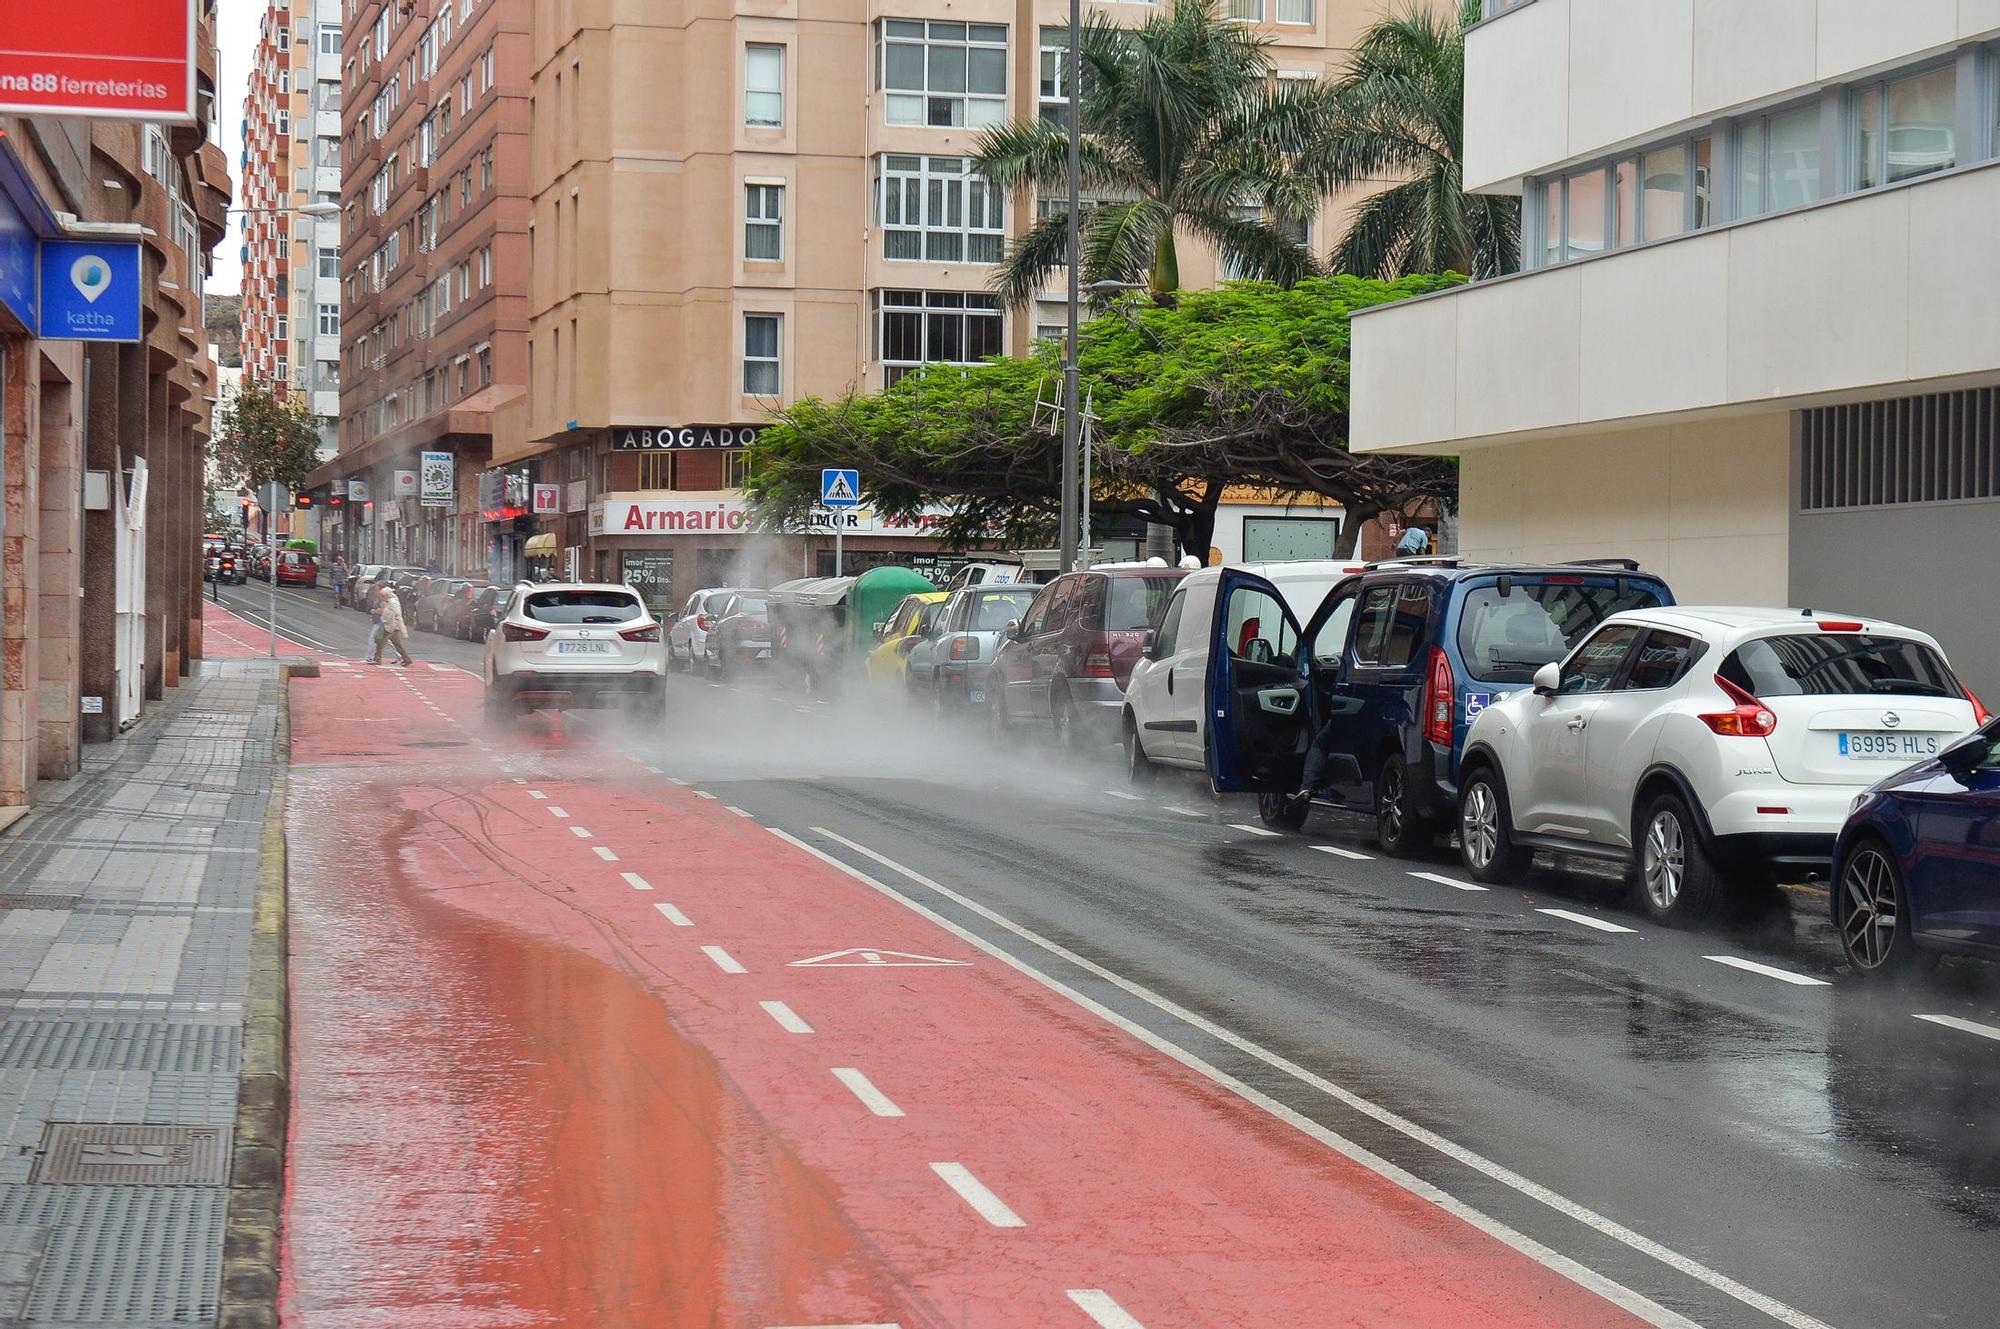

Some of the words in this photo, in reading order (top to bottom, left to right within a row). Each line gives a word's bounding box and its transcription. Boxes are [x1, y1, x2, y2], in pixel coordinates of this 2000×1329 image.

[0, 73, 58, 92] na88
[66, 310, 115, 325] katha
[625, 558, 644, 566] imor
[913, 556, 935, 565] imor
[623, 569, 656, 583] 25%
[1851, 735, 1897, 754] 6995
[1903, 736, 1938, 754] HLS
[1735, 767, 1773, 776] JUKE
